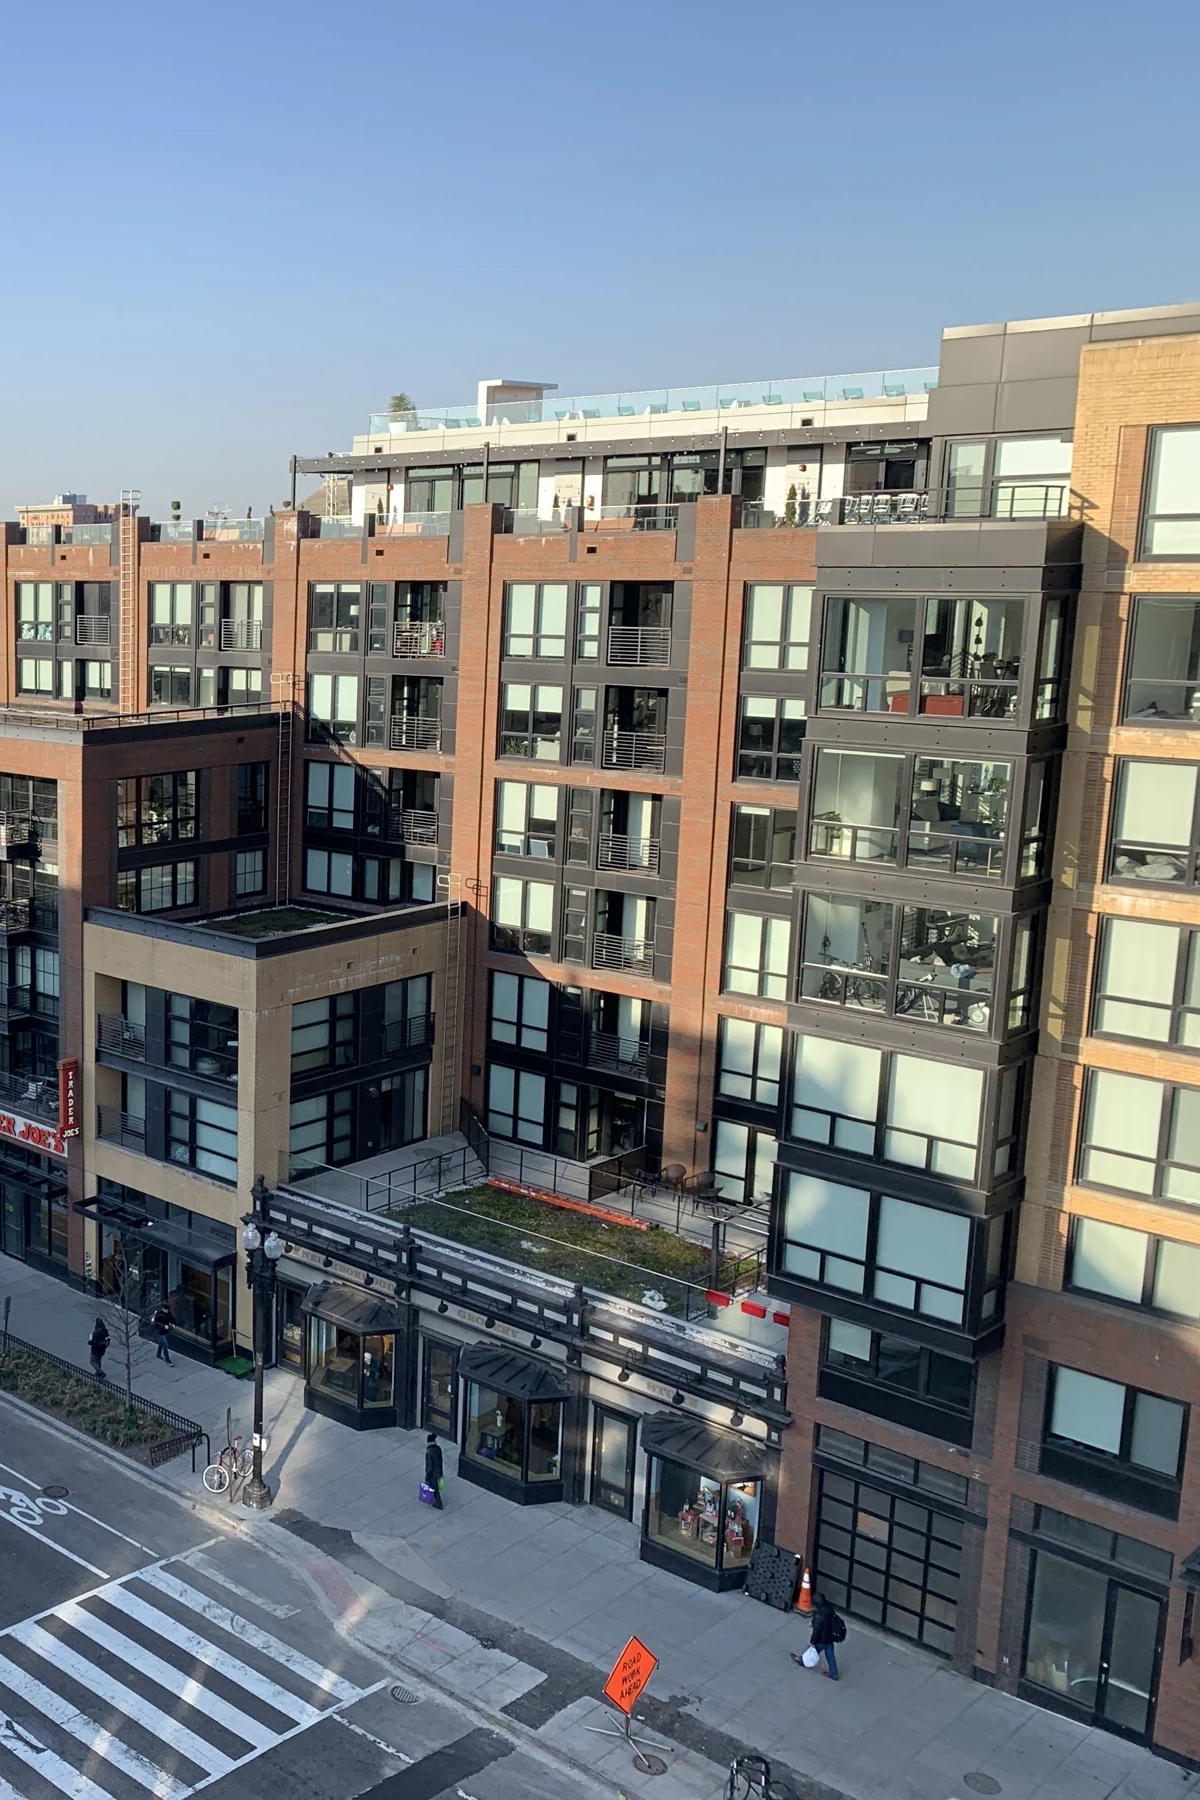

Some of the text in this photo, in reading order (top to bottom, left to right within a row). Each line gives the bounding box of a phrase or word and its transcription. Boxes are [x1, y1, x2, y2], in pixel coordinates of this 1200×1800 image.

[67, 1071, 75, 1125] TRADER
[19, 1122, 64, 1153] JOE'S
[62, 1127, 80, 1138] JOE'S
[457, 1308, 519, 1338] GROERY
[647, 1382, 697, 1408] STOE
[623, 1652, 642, 1673] ROAD
[621, 1666, 641, 1686] WORK
[620, 1679, 641, 1700] AHEAD
